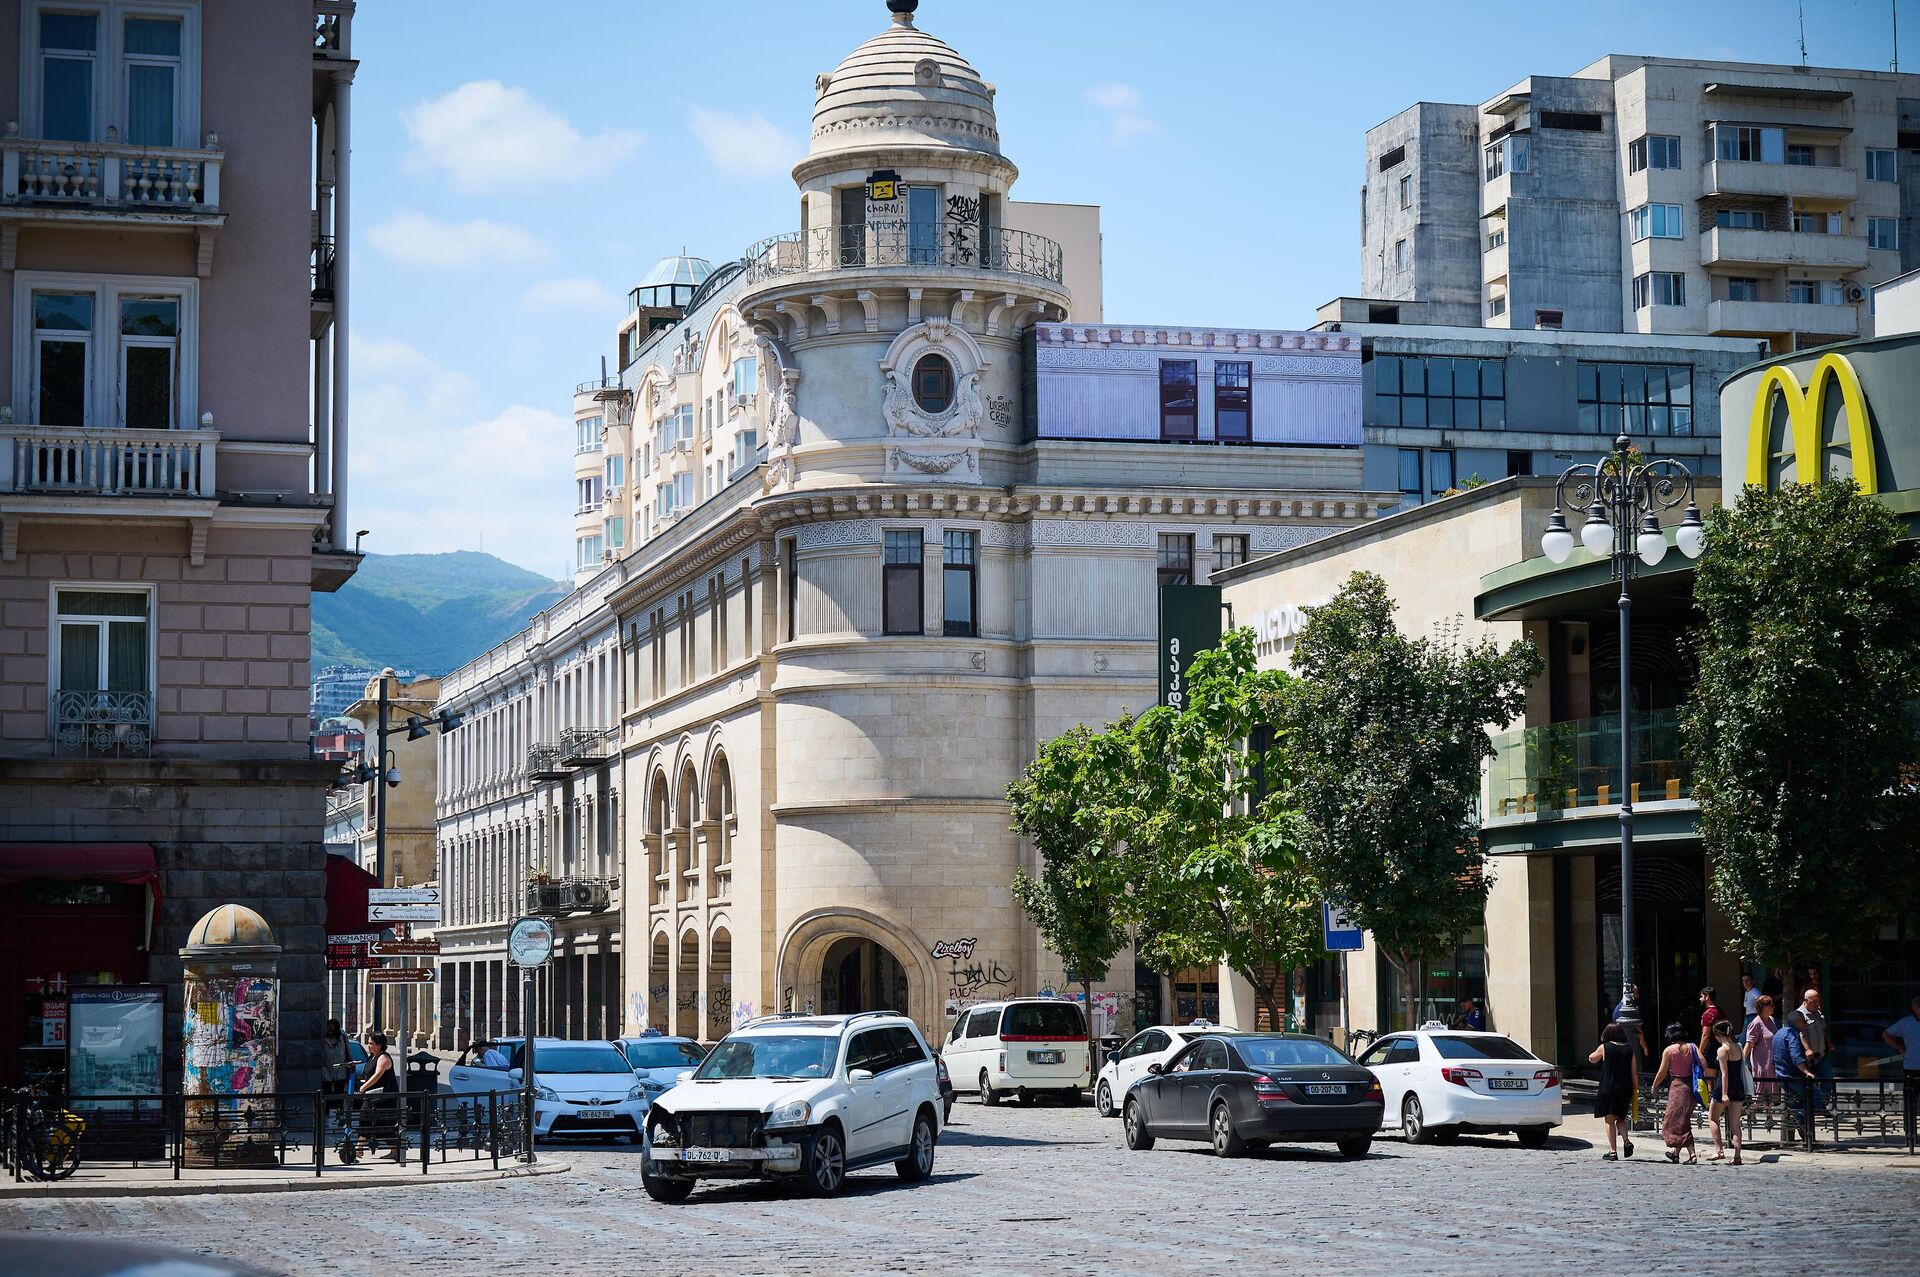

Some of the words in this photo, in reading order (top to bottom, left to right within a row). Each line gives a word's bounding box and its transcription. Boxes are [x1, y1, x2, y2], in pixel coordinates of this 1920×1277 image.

[990, 411, 1011, 425] CREW
[329, 934, 379, 942] EXCHANGE
[931, 938, 977, 959] Pixelboy
